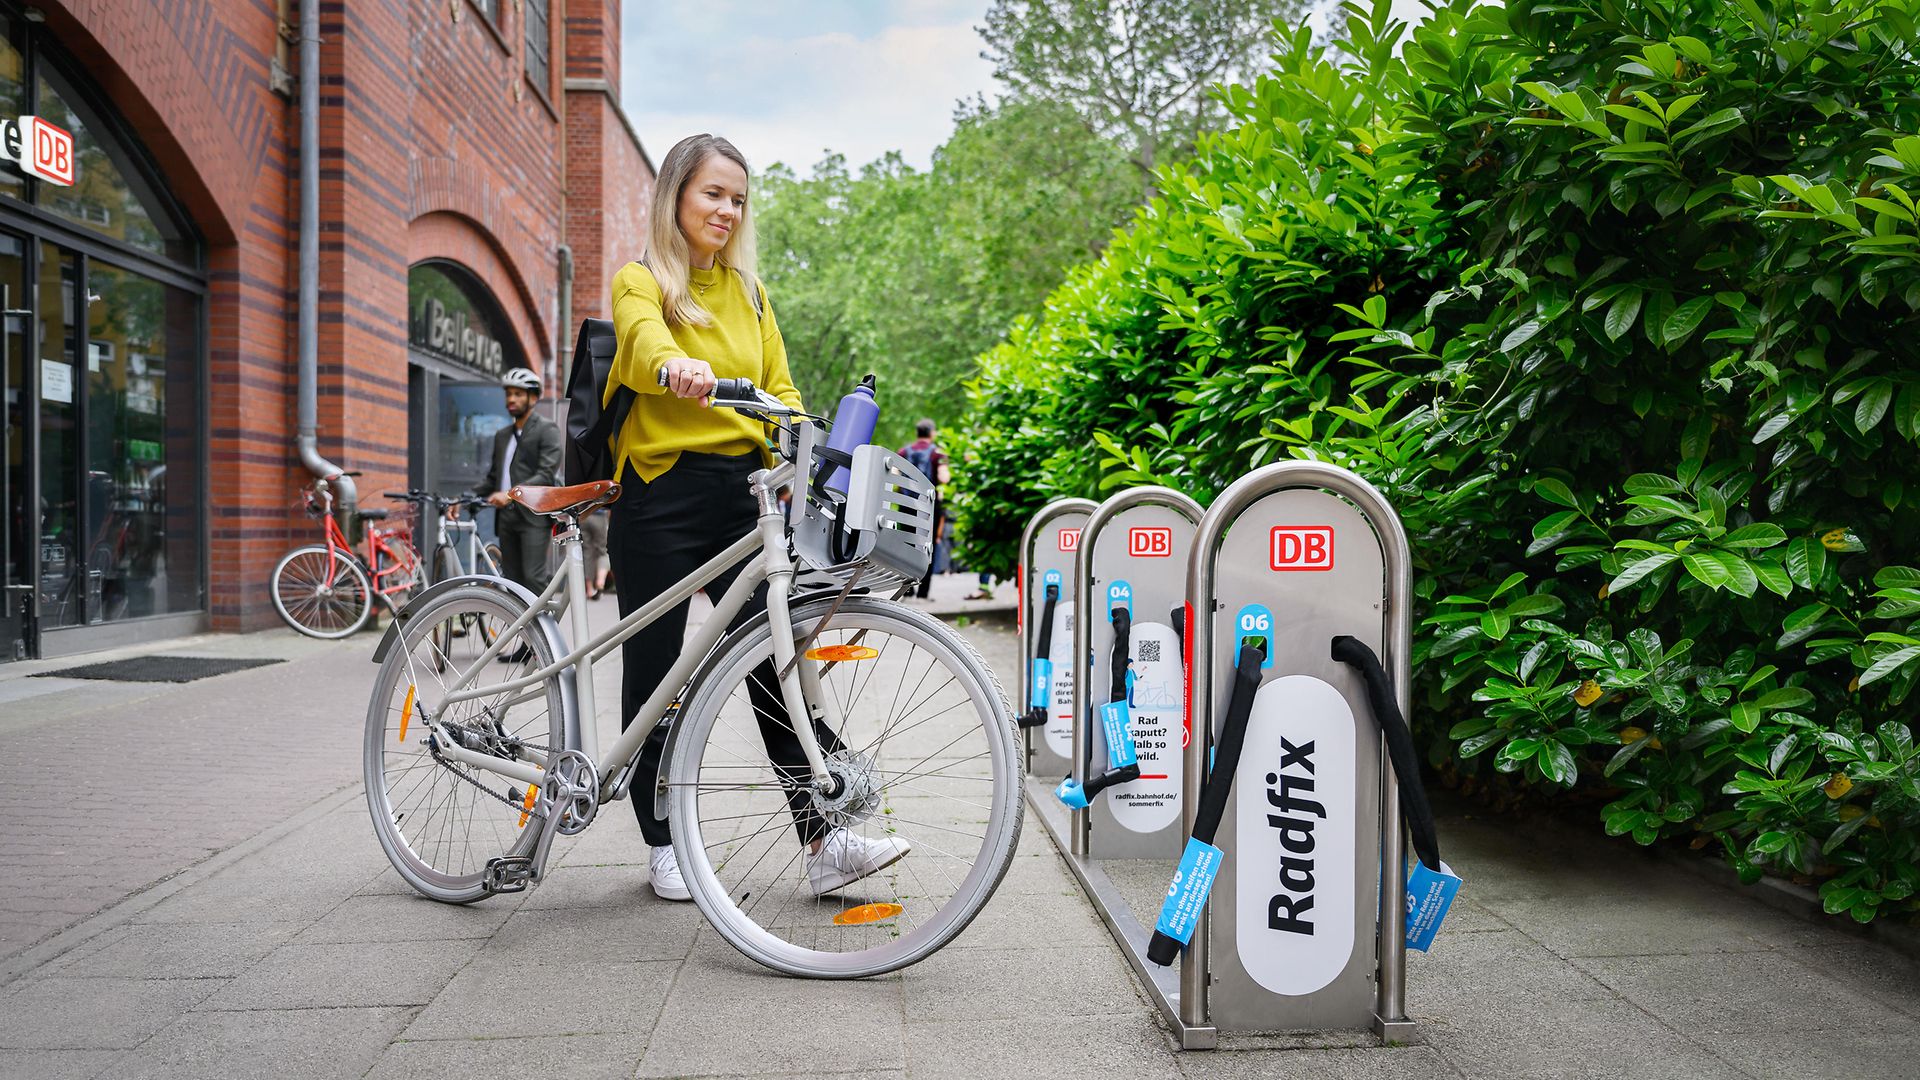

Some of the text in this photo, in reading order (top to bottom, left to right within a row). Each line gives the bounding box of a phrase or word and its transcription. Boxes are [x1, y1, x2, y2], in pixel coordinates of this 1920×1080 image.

[39, 128, 68, 173] DB
[426, 299, 502, 373] Bellevue
[1135, 532, 1166, 552] DB
[1279, 534, 1326, 564] DB
[1046, 574, 1060, 582] 02
[1110, 586, 1130, 598] 04
[1241, 614, 1269, 630] 06
[1138, 716, 1158, 724] Rad
[1266, 736, 1326, 936] Radfix
[1169, 851, 1205, 928] Bitte ohne Reifen und
[1176, 852, 1213, 935] direkt an dieses Schloss
[1420, 894, 1432, 912] Reifen
[1429, 882, 1437, 894] und
